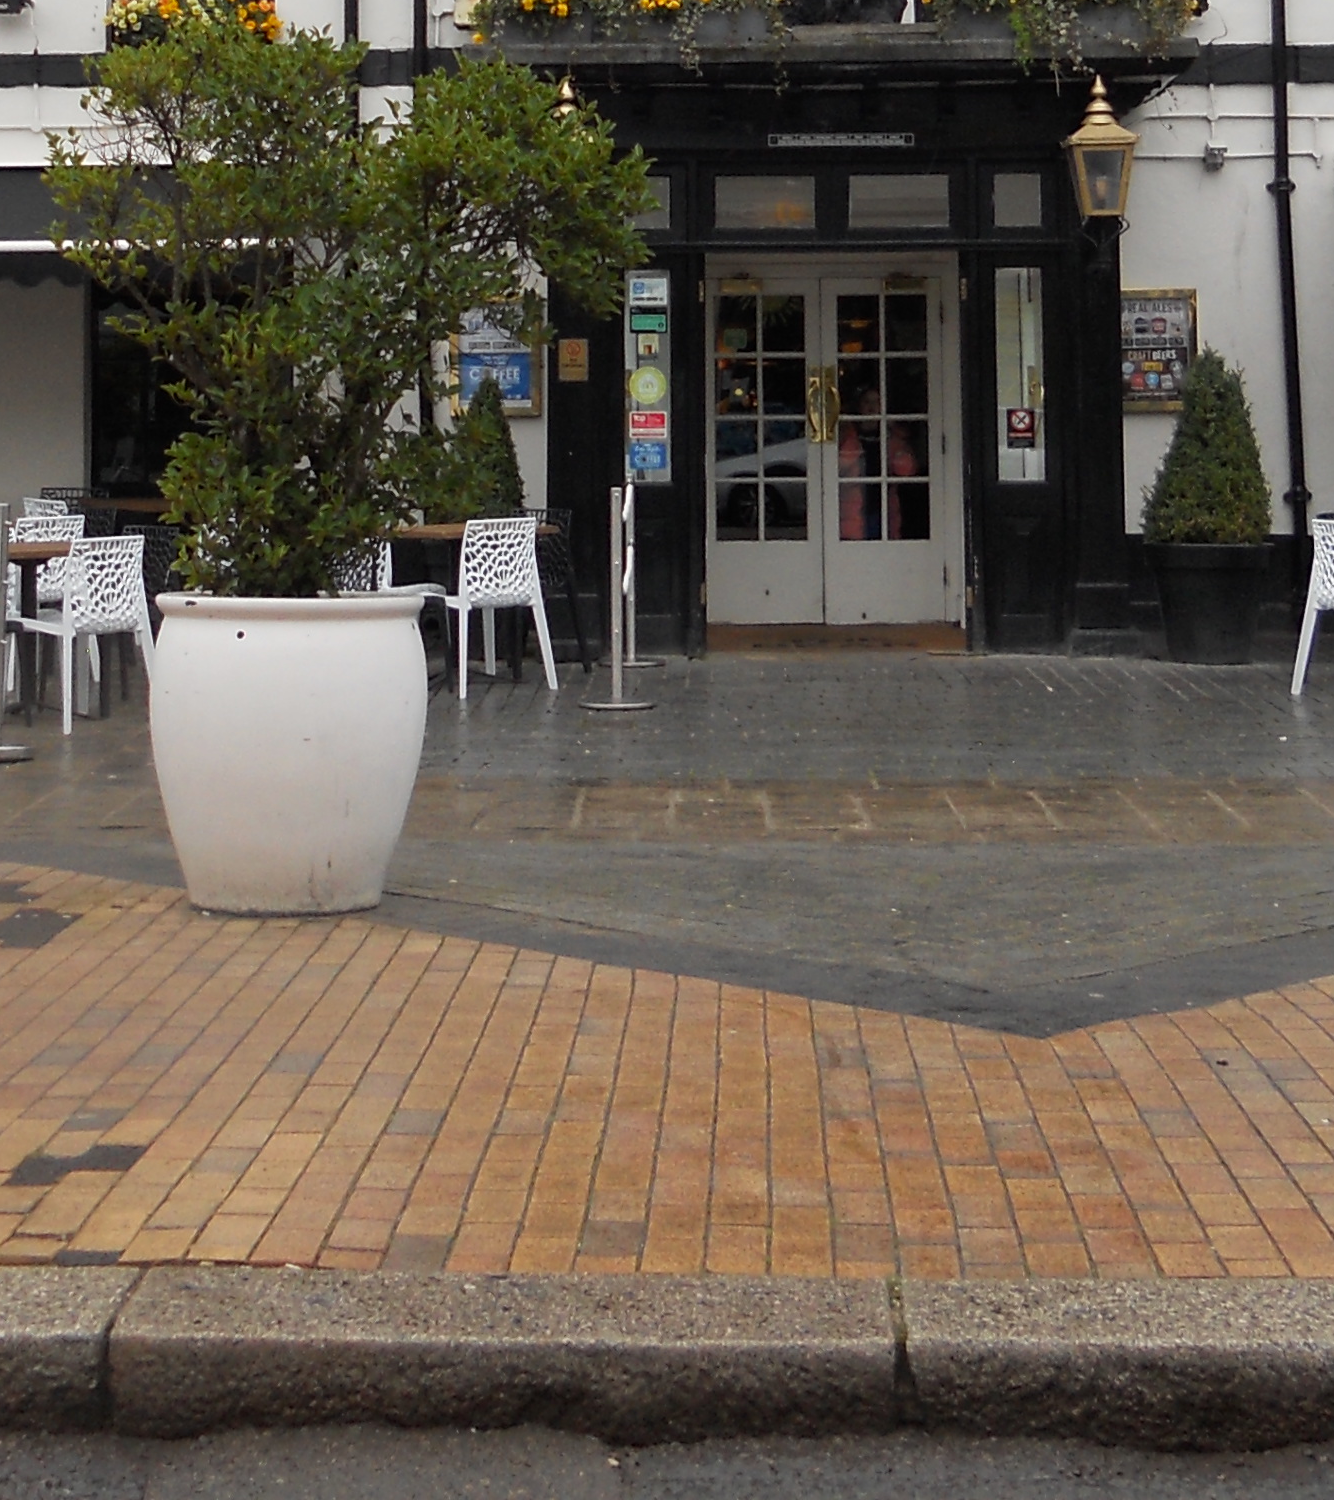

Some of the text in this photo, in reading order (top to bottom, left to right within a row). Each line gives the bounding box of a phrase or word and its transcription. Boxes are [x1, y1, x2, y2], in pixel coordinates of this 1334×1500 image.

[1127, 300, 1173, 314] REAL ALES
[1127, 348, 1177, 361] CRAFT BEERS
[468, 366, 521, 382] CFFEE
